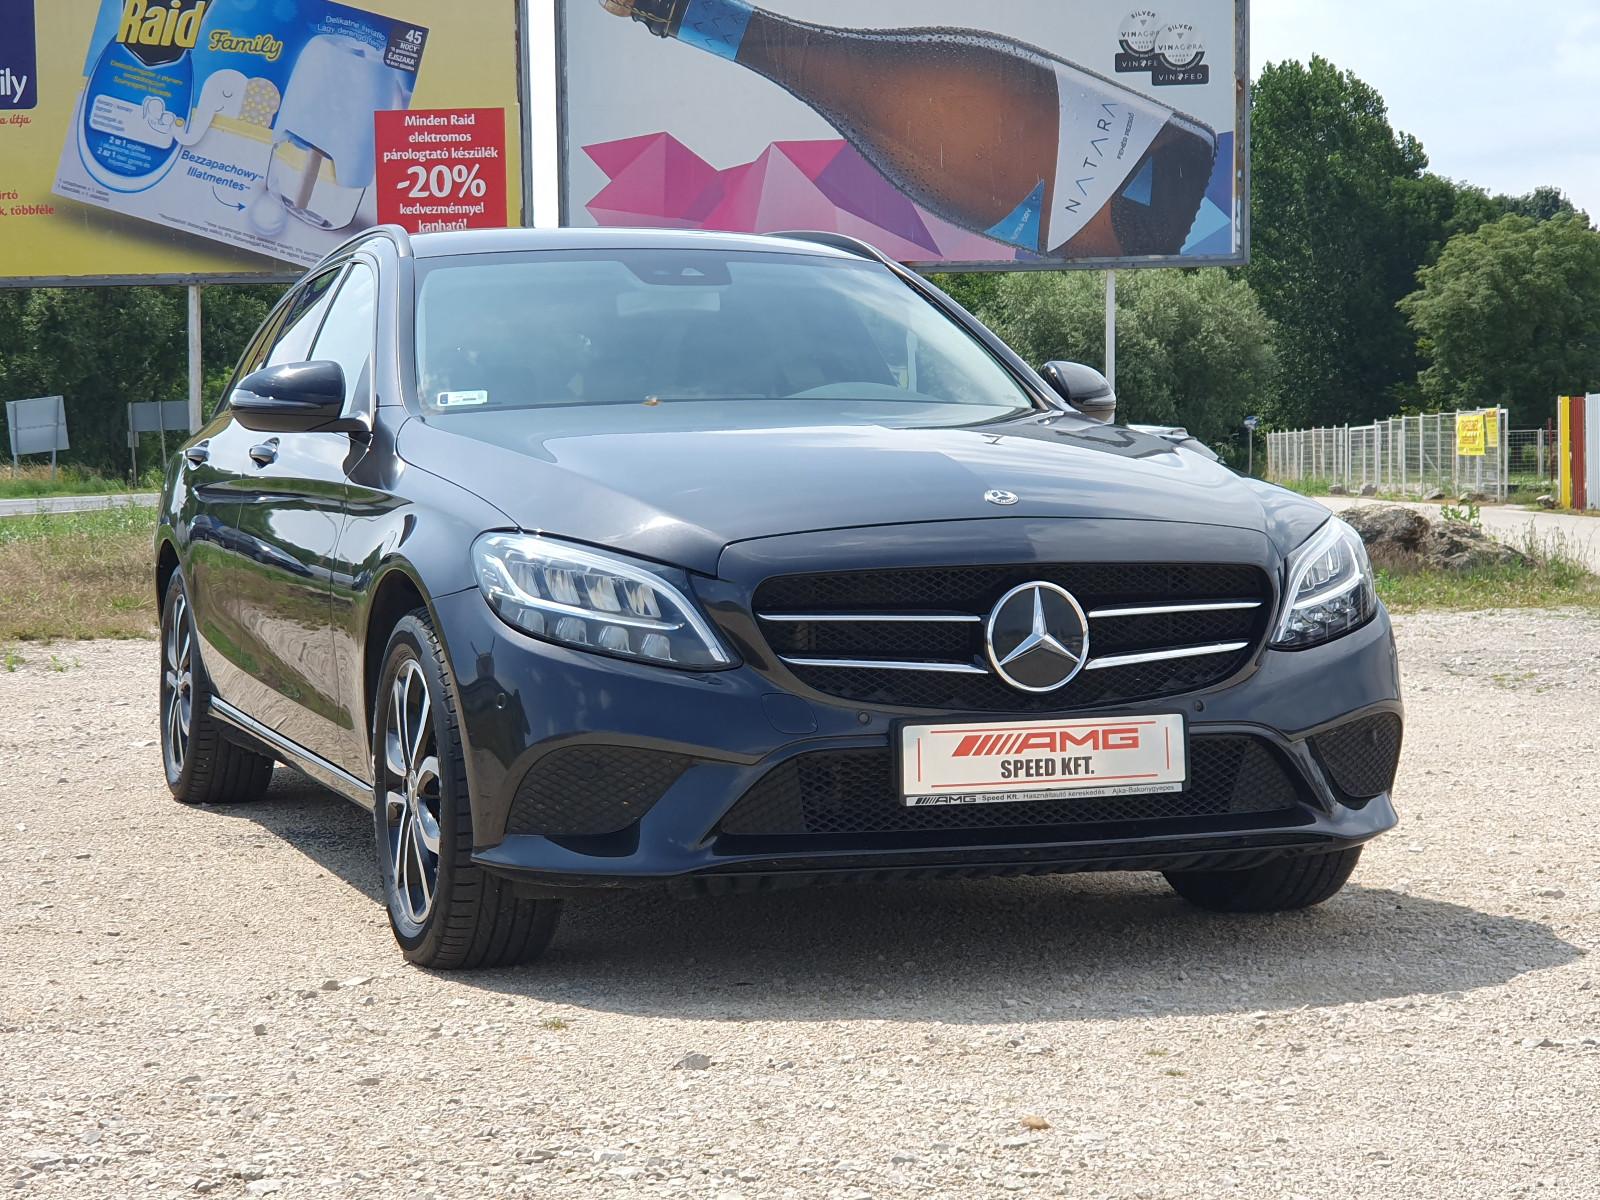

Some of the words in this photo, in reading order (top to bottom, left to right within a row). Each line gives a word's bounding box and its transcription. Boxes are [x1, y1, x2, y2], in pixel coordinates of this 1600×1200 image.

[1130, 10, 1156, 19] SILVER
[116, 0, 206, 49] Raid
[1167, 23, 1193, 33] SILVER
[208, 29, 284, 61] Family
[405, 29, 422, 45] 45
[404, 115, 448, 127] Minden
[450, 113, 475, 125] Raid
[408, 131, 472, 143] elektromos
[383, 148, 449, 163] párologtató
[451, 146, 498, 159] készülék
[1064, 102, 1119, 214] NATARA
[396, 163, 487, 198] -20%
[10, 203, 55, 216] többféle
[399, 202, 485, 217] kedvezménnyel
[1016, 727, 1140, 755] AMG
[1000, 757, 1057, 779] SPEED
[1061, 756, 1095, 777] KFT.
[934, 795, 977, 805] AMG
[981, 794, 1005, 802] Speed
[1006, 793, 1019, 801] Kft.
